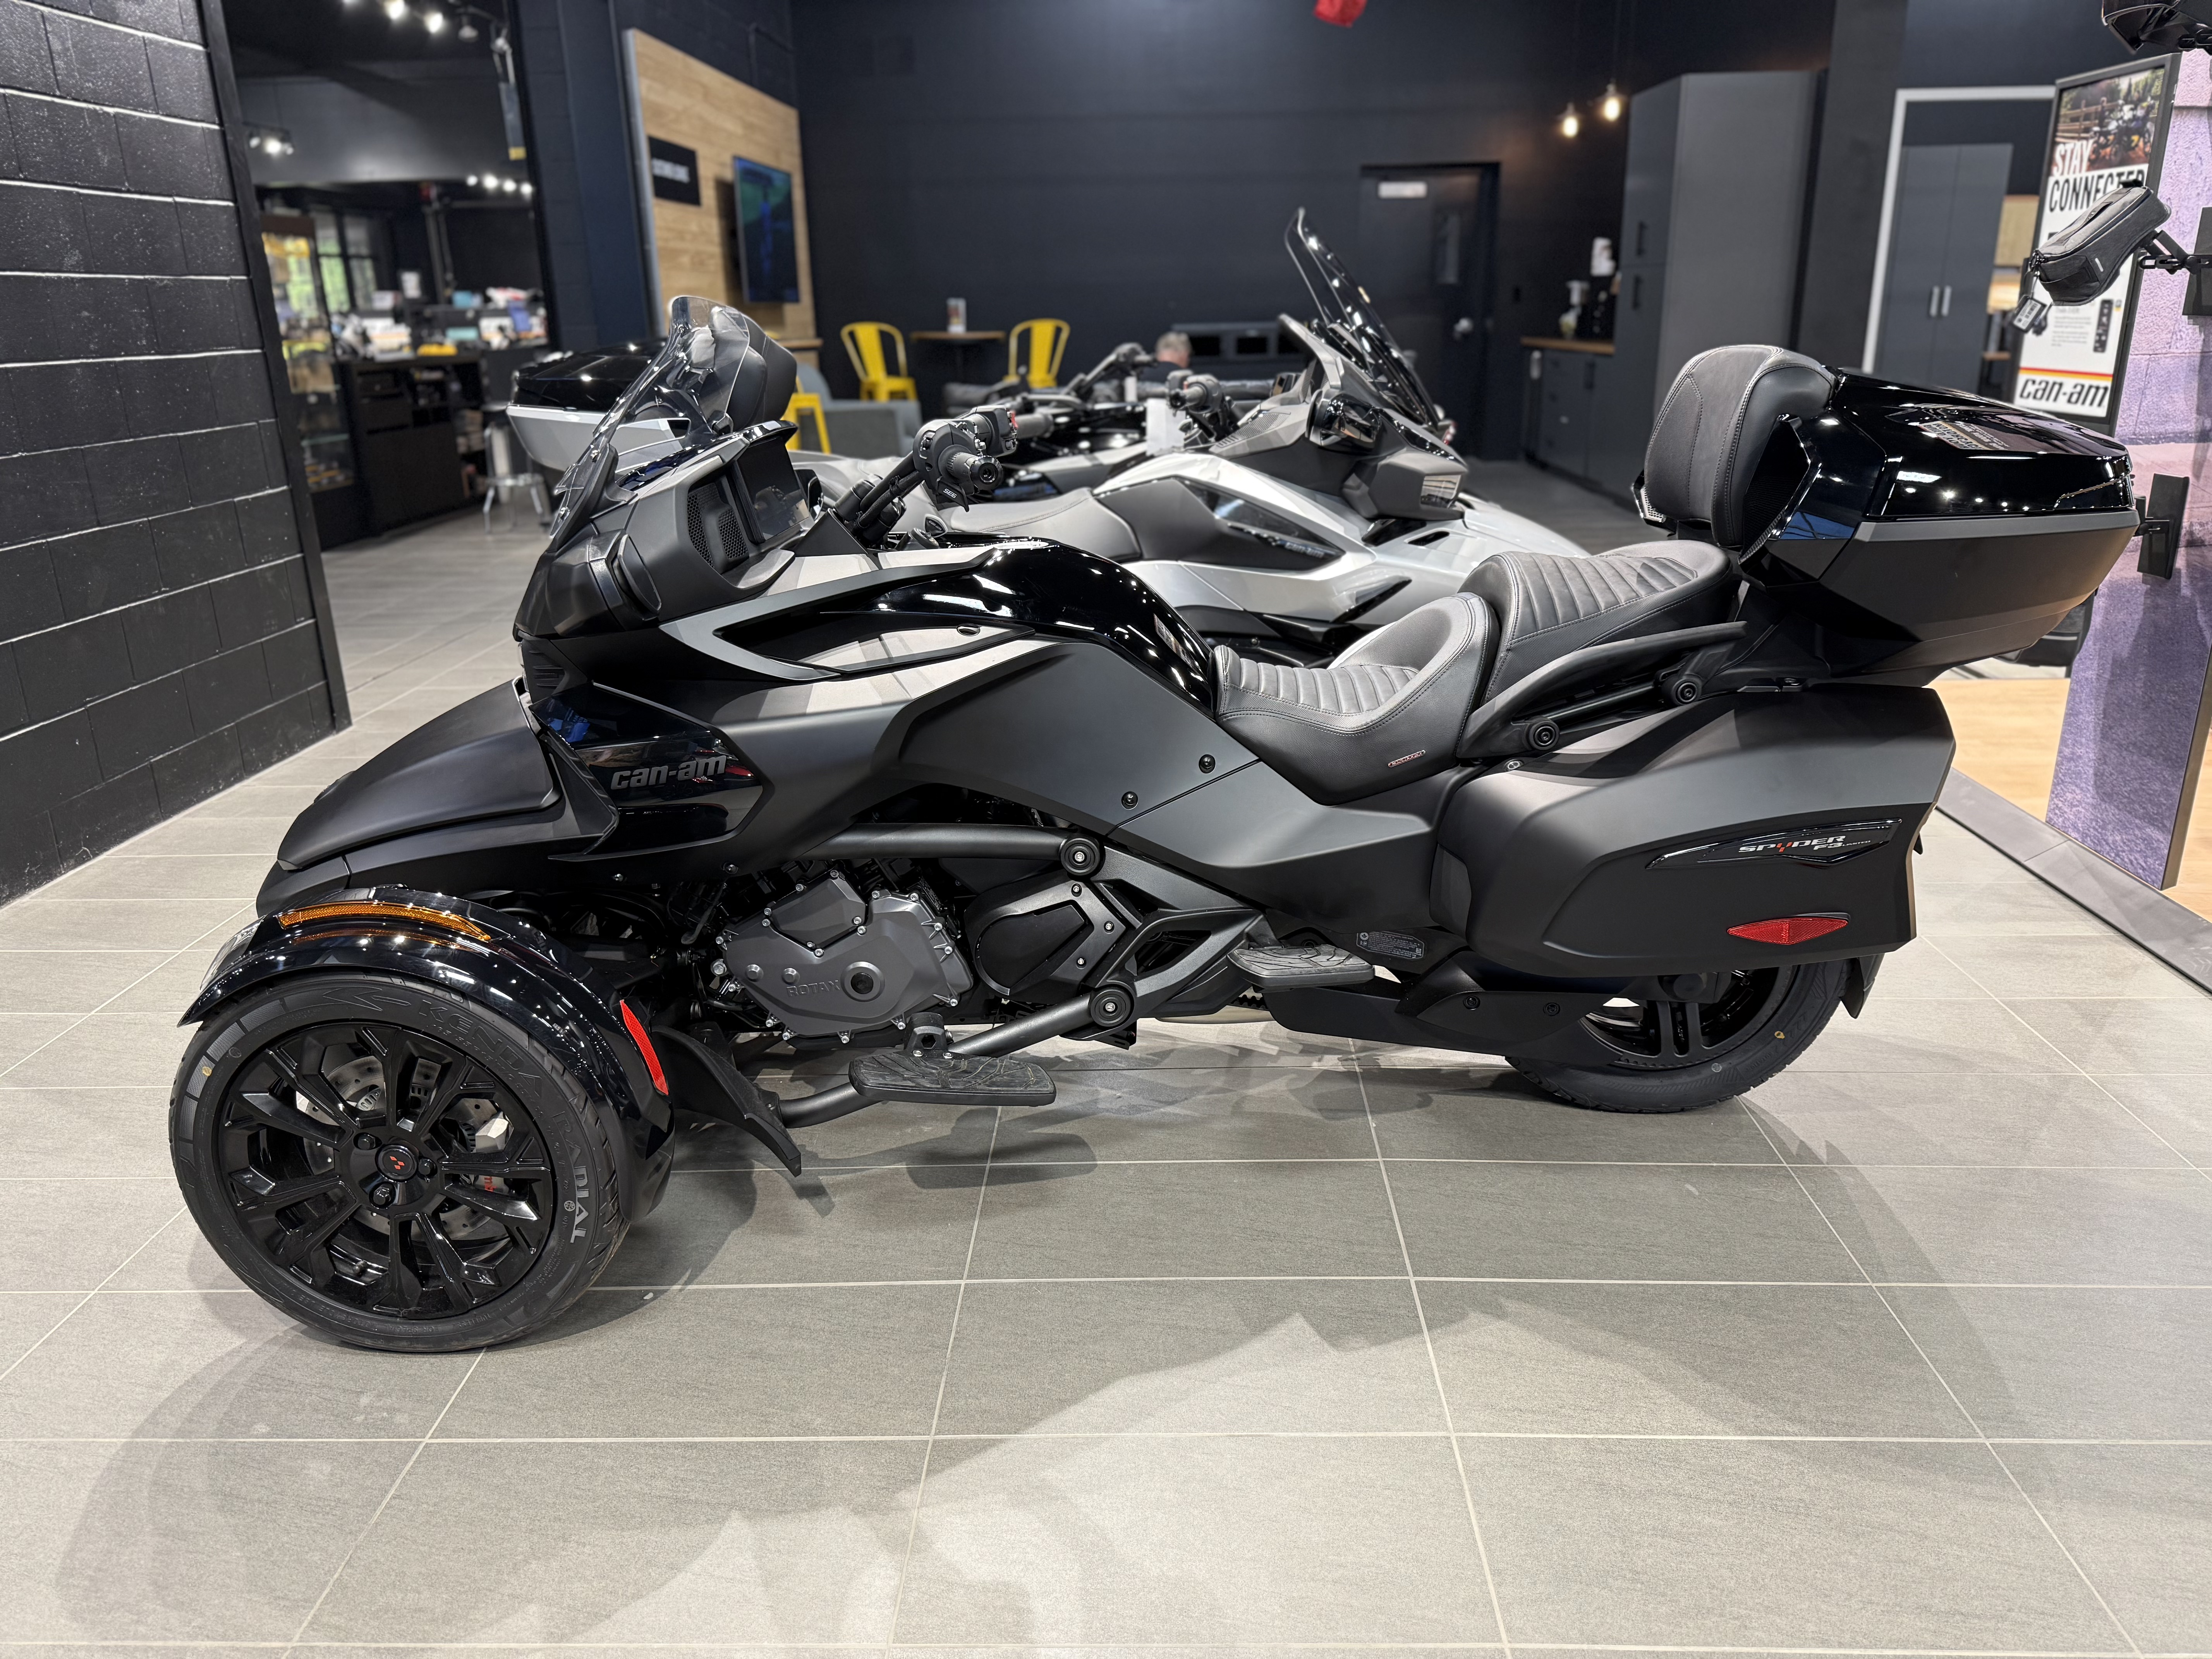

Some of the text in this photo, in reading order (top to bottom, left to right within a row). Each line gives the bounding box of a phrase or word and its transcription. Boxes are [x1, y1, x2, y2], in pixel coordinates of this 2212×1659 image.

[2053, 140, 2094, 176] STAY
[2049, 169, 2145, 212] CONNEC
[2020, 378, 2109, 408] can-am
[943, 488, 957, 498] SE6
[611, 755, 727, 790] can-am
[1738, 835, 1846, 852] SPYDER
[1813, 842, 1843, 850] F3
[787, 980, 840, 997] ROTAX
[418, 1000, 543, 1098] KENDA
[552, 1111, 589, 1244] RADIAL
